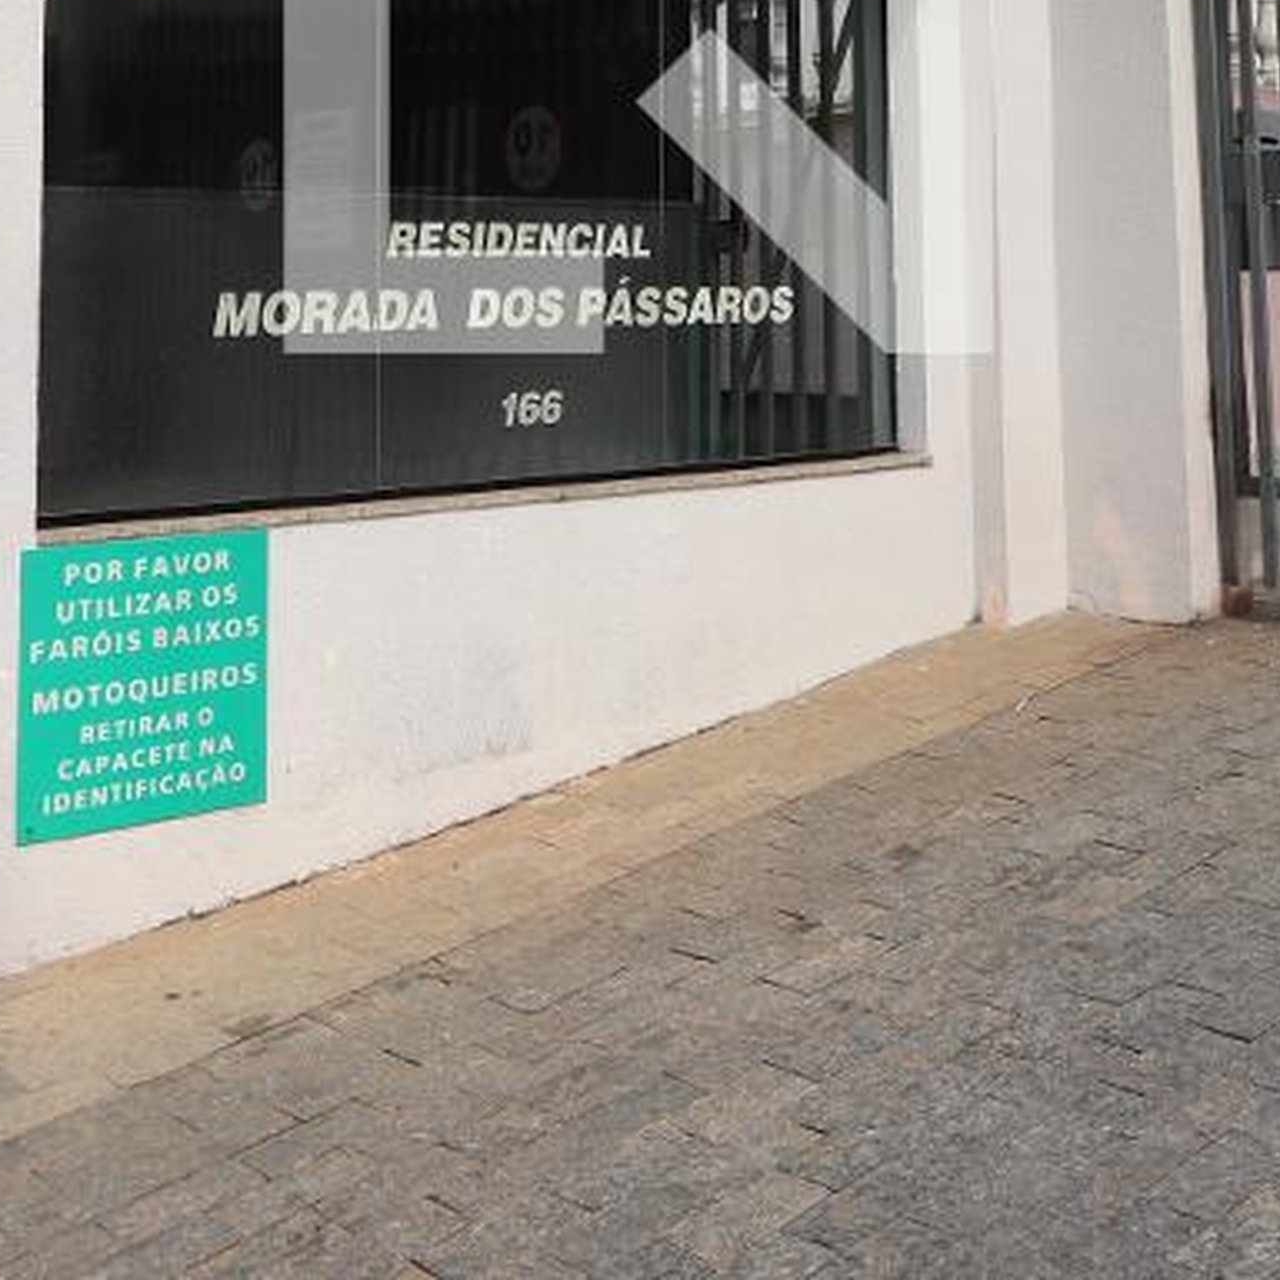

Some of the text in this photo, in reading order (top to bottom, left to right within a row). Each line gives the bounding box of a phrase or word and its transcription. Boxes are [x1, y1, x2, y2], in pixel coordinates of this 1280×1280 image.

[386, 221, 651, 259] RESIDENCIAL
[213, 276, 795, 337] MORADA DOS PÁSSAROS
[501, 389, 564, 428] 166
[64, 551, 230, 586] POR FAVOR
[56, 583, 238, 624] UTILIZAR OS
[29, 614, 261, 665] FARÓIS BAIXOS
[32, 661, 258, 716] MOTOQUEIROS
[80, 706, 215, 745] RETIRAR O
[57, 734, 235, 781] CAPACETE NA
